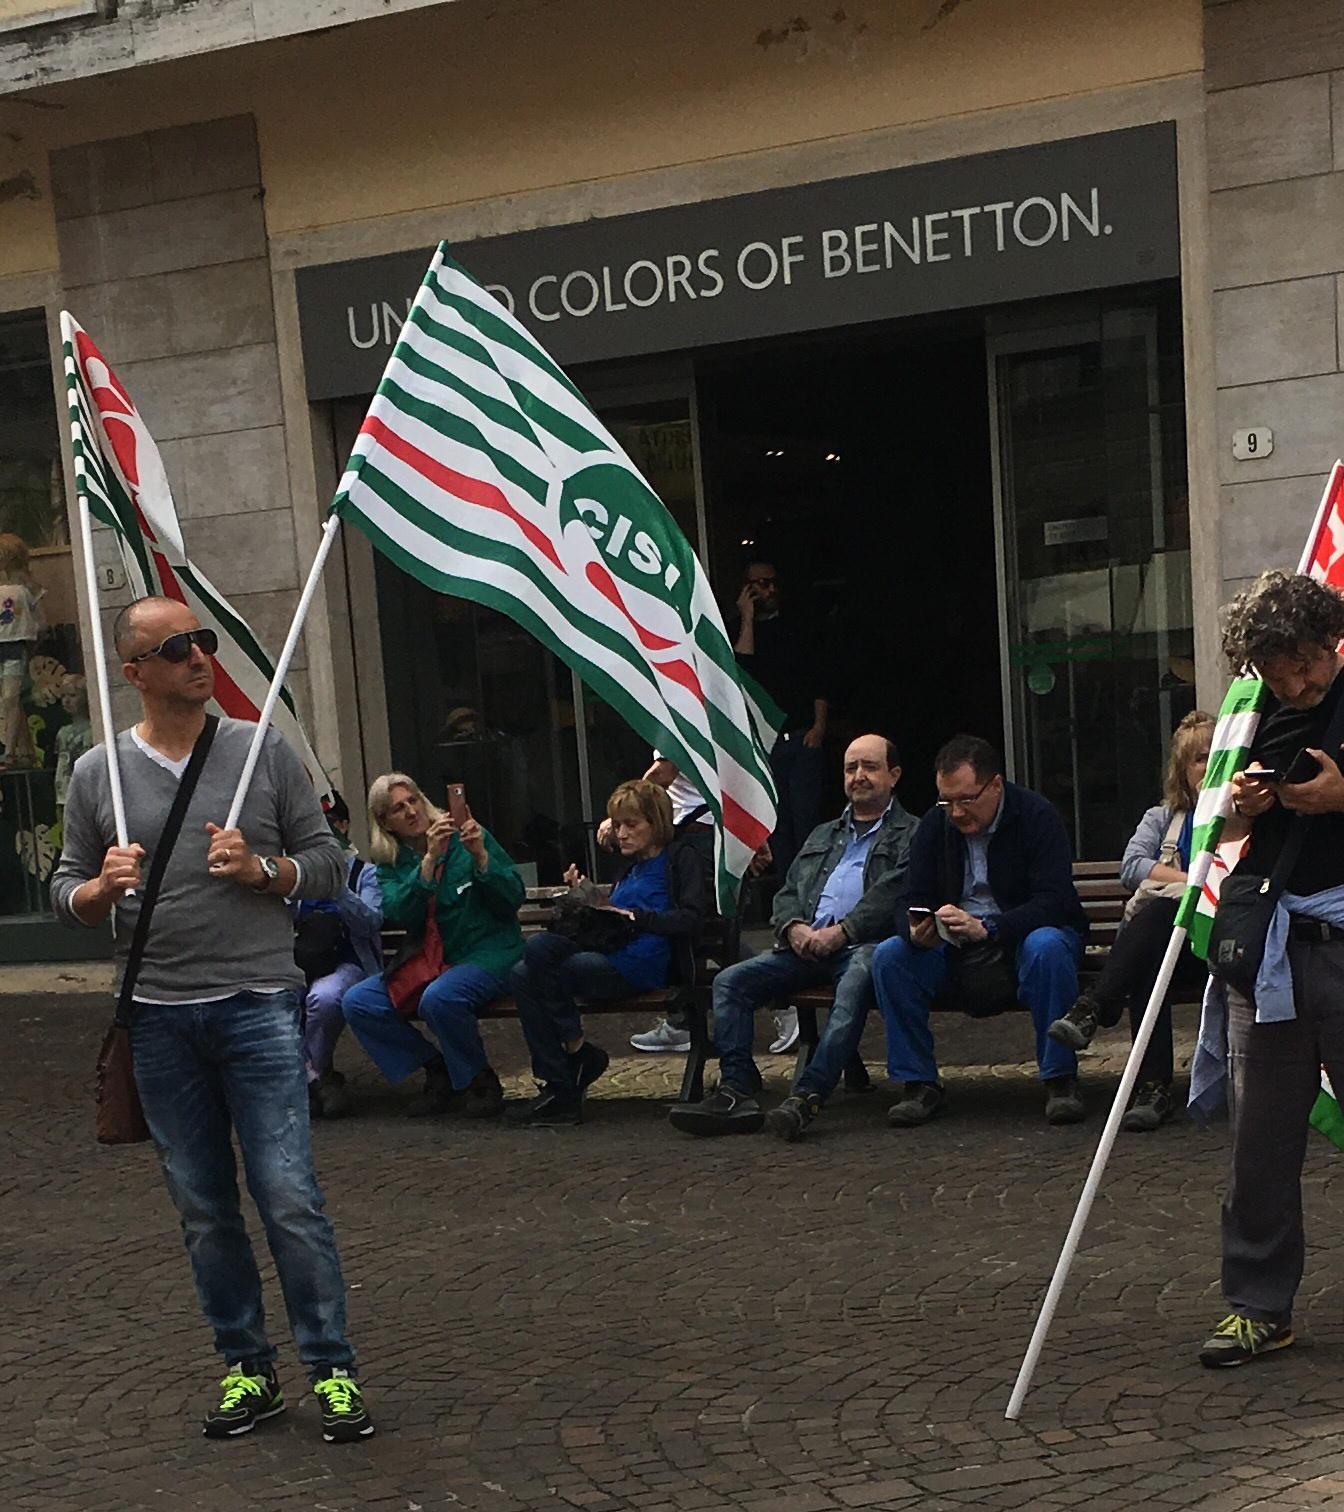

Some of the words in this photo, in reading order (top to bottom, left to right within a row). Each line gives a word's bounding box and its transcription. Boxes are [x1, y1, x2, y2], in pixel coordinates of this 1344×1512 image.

[528, 248, 725, 322] COLORS
[737, 234, 805, 290] OF
[822, 186, 1114, 279] BENETTON.
[1247, 432, 1258, 453] 9
[106, 568, 114, 585] 8
